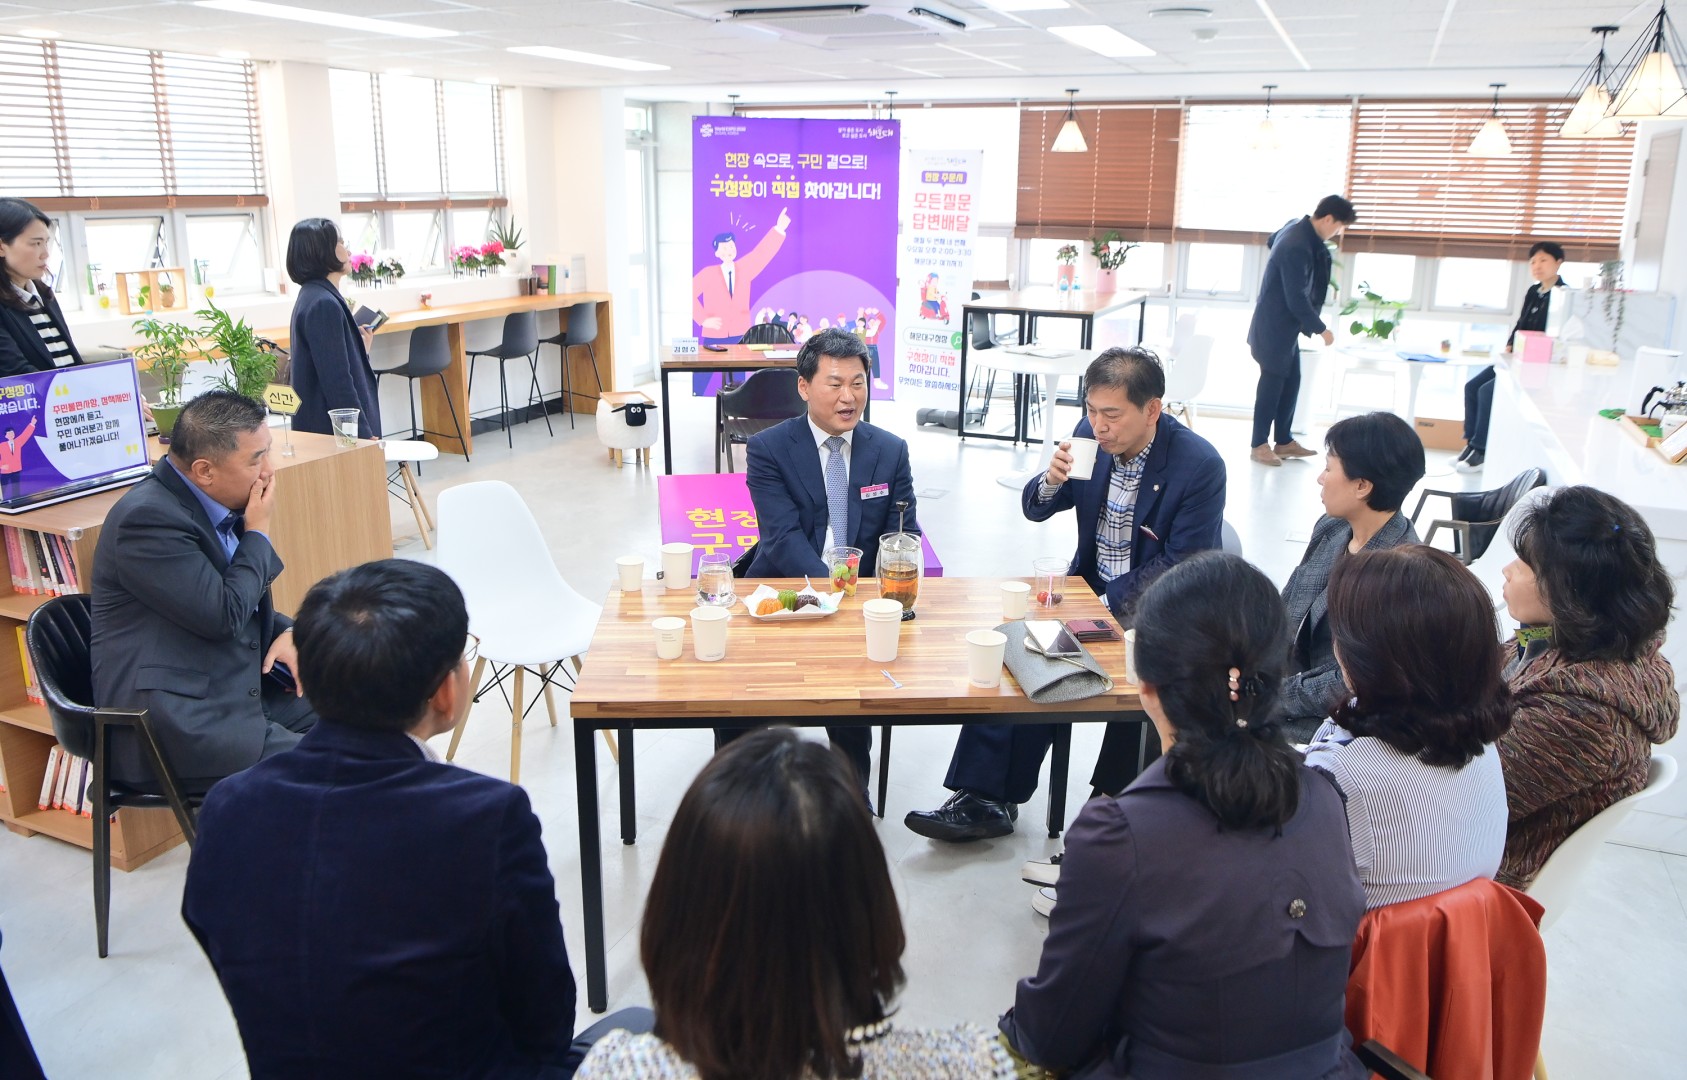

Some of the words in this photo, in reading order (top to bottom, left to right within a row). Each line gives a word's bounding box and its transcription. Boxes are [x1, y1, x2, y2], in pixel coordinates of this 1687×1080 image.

[725, 152, 750, 168] 현장
[753, 153, 794, 170] 속으로,
[797, 153, 822, 169] 구민
[826, 154, 868, 170] 곁으로!
[710, 179, 767, 198] 구청장이
[772, 181, 800, 199] 직접
[804, 181, 881, 200] 찾아갑니다!
[914, 193, 971, 211] 모든질문
[913, 213, 970, 232] 답변배달
[909, 332, 948, 344] 해운대구청장
[907, 352, 938, 364] 구청장이
[940, 355, 956, 367] 직접
[909, 364, 950, 378] 찾아갑니다.
[269, 392, 294, 406] 신간
[55, 413, 85, 427] 현장에서
[57, 428, 73, 439] 주민
[74, 422, 103, 436] 여러분과
[105, 419, 120, 430] 함께
